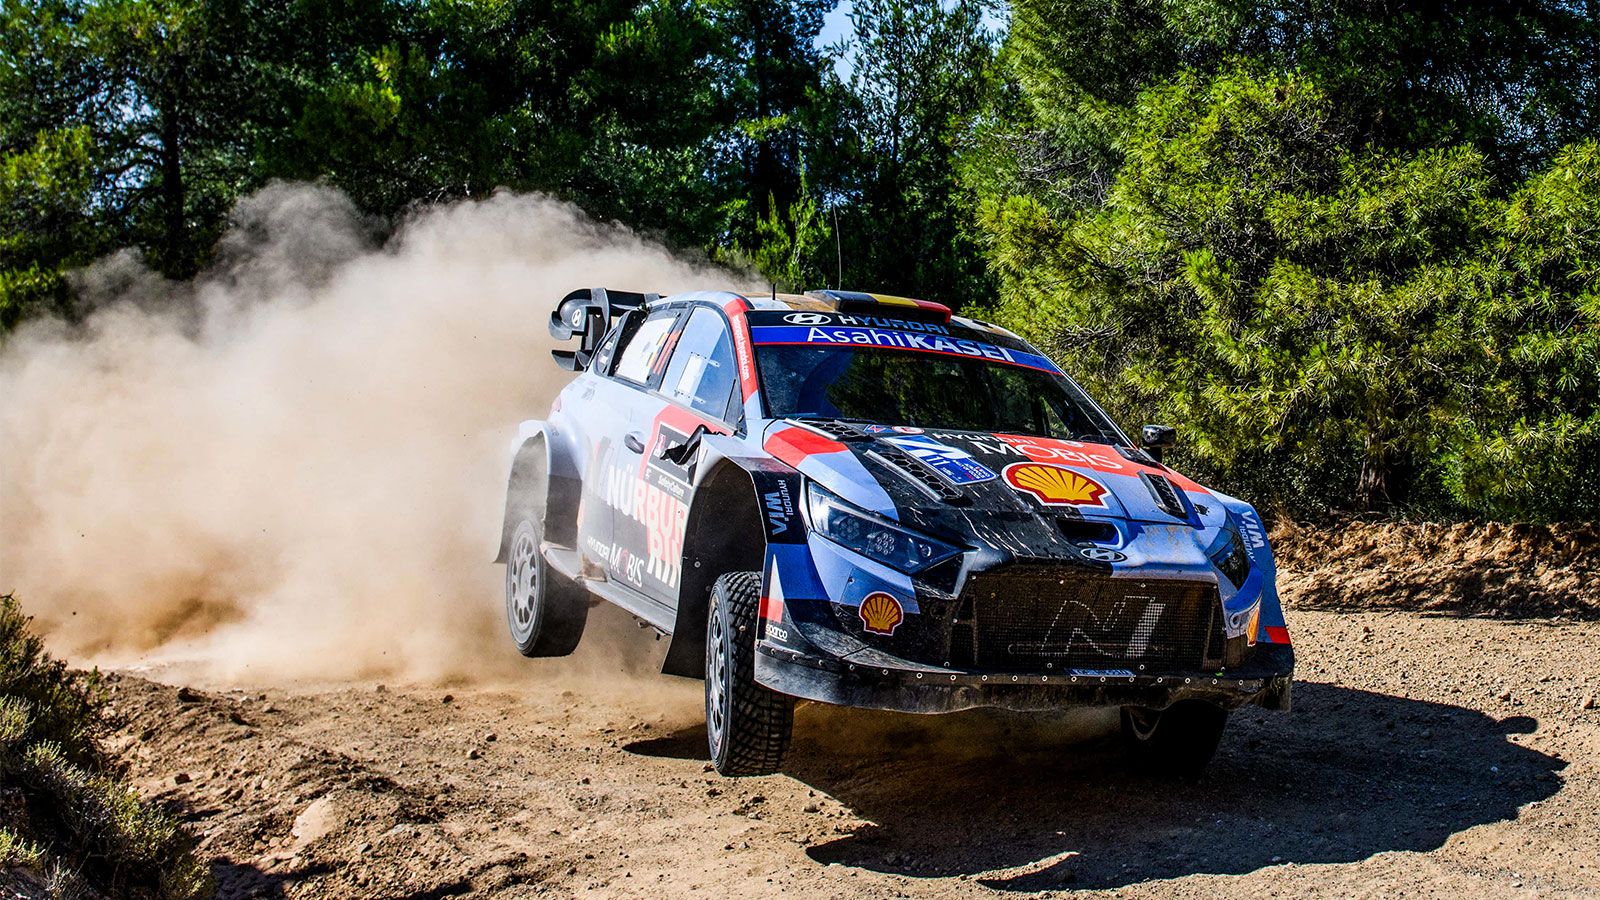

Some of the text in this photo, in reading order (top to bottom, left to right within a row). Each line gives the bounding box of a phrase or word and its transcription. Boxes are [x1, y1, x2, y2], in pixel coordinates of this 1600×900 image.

[837, 315, 950, 335] HYUNDAI
[932, 432, 1039, 446] HYUNDAI
[969, 440, 1123, 469] MOBIS
[765, 491, 788, 535] WIA
[777, 479, 795, 516] HYUNDAI
[1241, 510, 1265, 548] WIA
[609, 542, 645, 587] MOBIS
[765, 623, 788, 640] sparco
